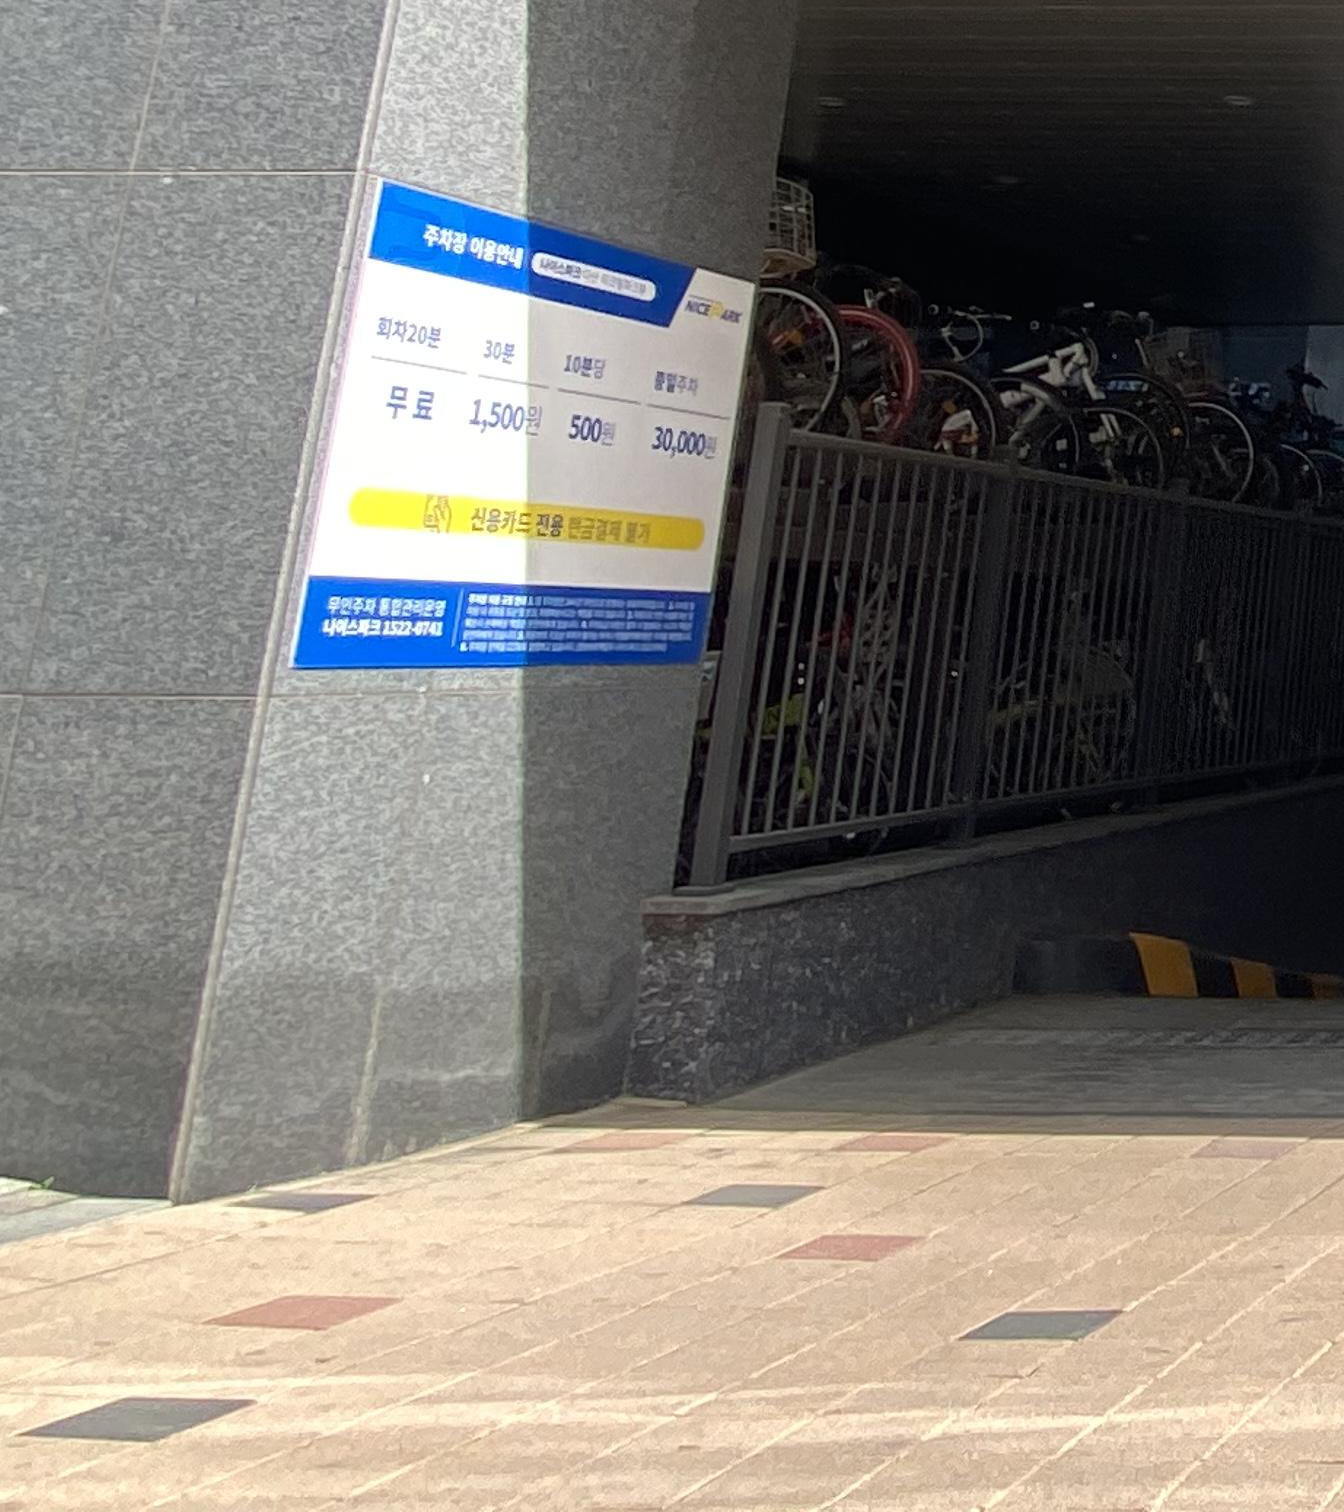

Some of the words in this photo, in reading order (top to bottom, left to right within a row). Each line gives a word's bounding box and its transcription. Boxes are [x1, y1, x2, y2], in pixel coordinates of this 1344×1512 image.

[422, 223, 468, 255] 주차장
[469, 236, 525, 270] 이용안내
[483, 339, 515, 365] 30분
[471, 506, 532, 535] 신용카드
